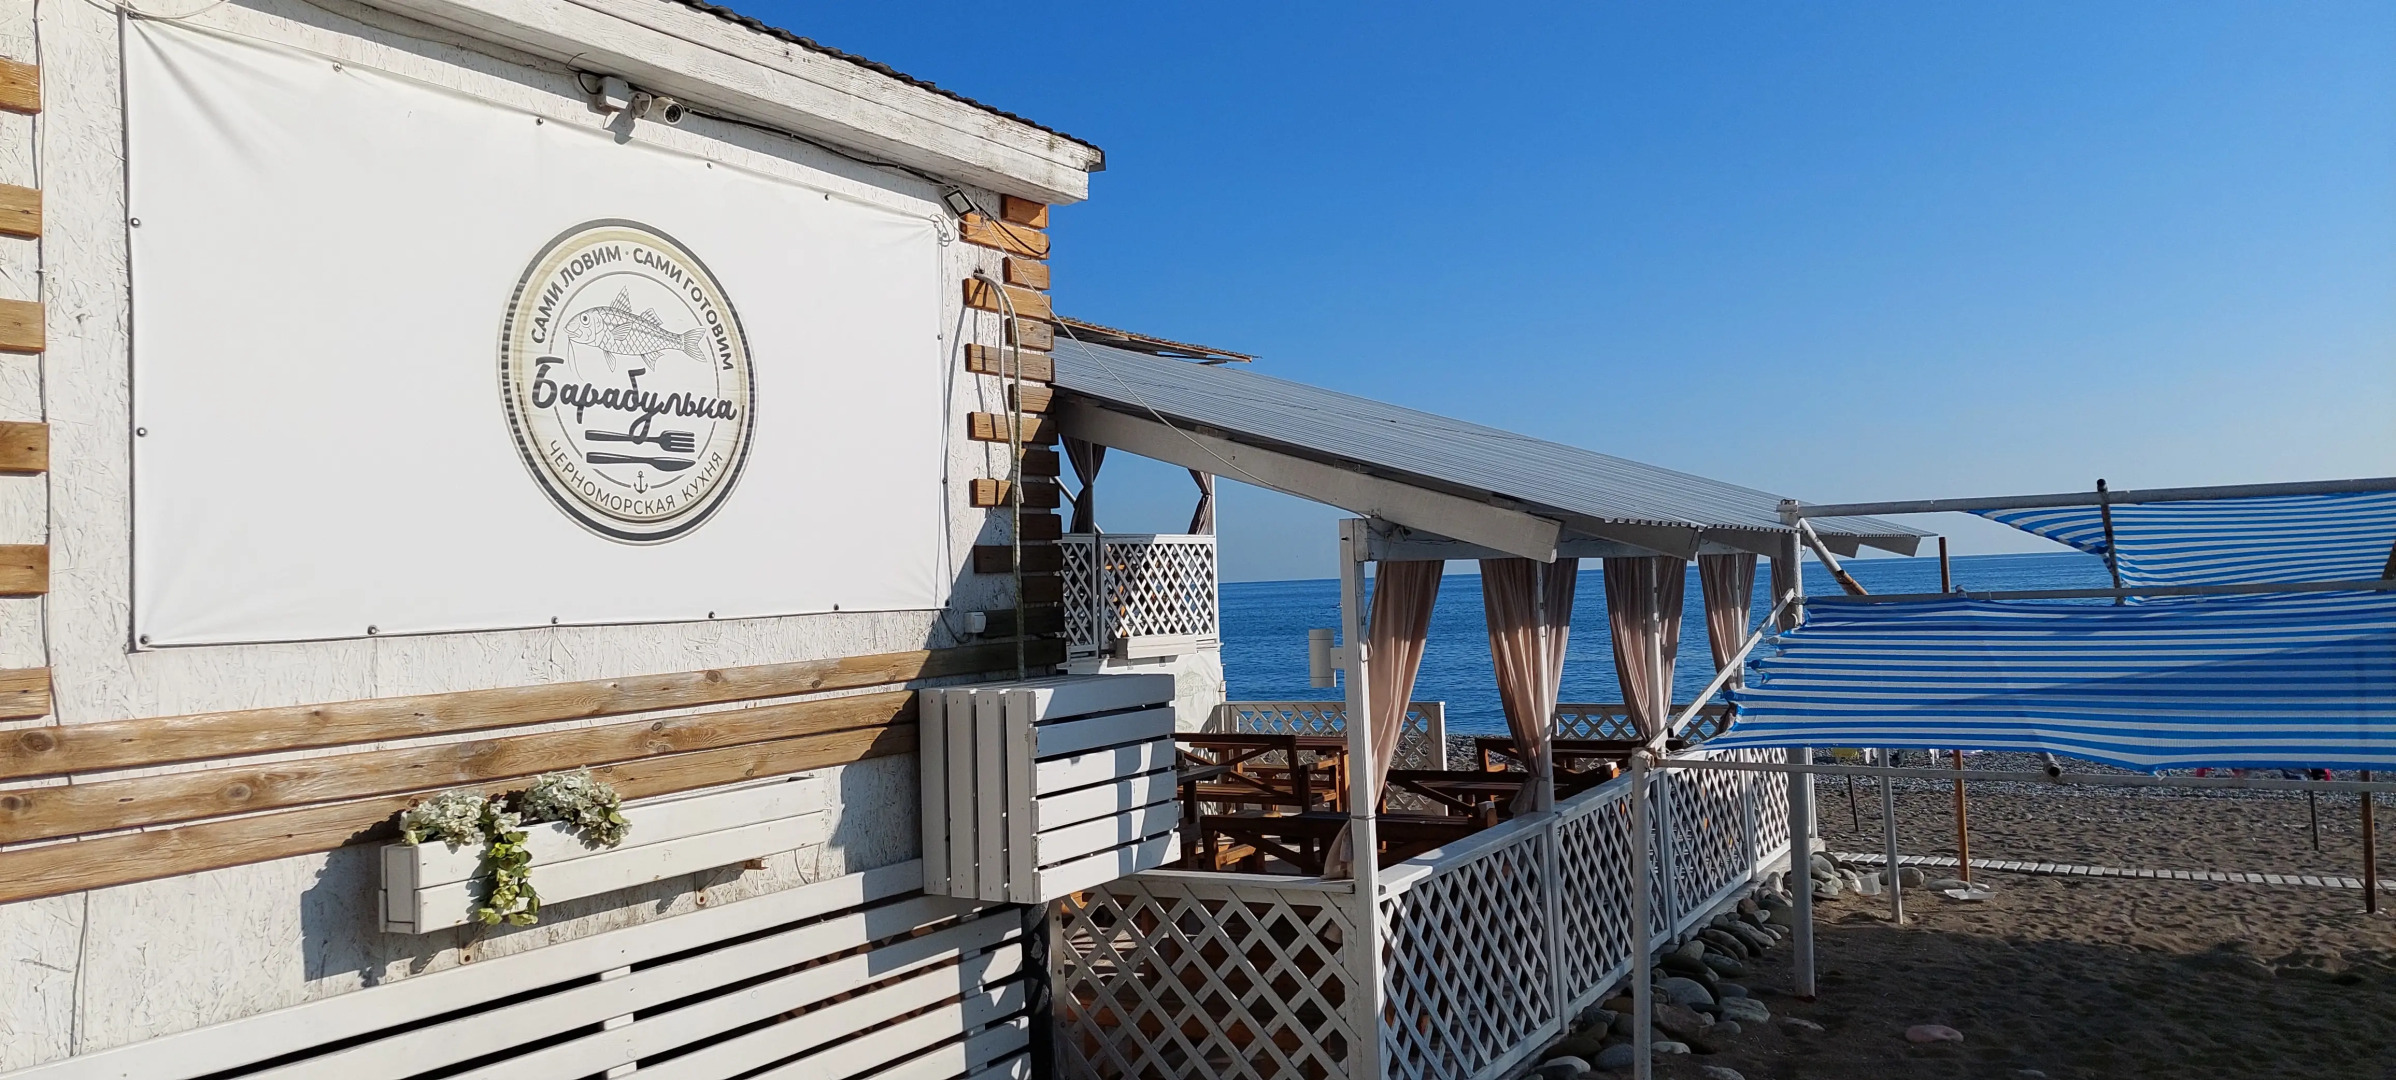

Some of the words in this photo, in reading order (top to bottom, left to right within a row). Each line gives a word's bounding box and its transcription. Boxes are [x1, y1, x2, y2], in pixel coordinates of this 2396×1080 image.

[532, 281, 563, 343] САМИ
[561, 246, 621, 287] ЛОВИМ
[633, 247, 682, 284] САМИ
[683, 279, 734, 371] ГОТОВИМ
[531, 356, 737, 443] Барабулька
[549, 440, 675, 515] ЧЕРНОМОРСКАЯ
[683, 451, 723, 500] КУХНЯ
